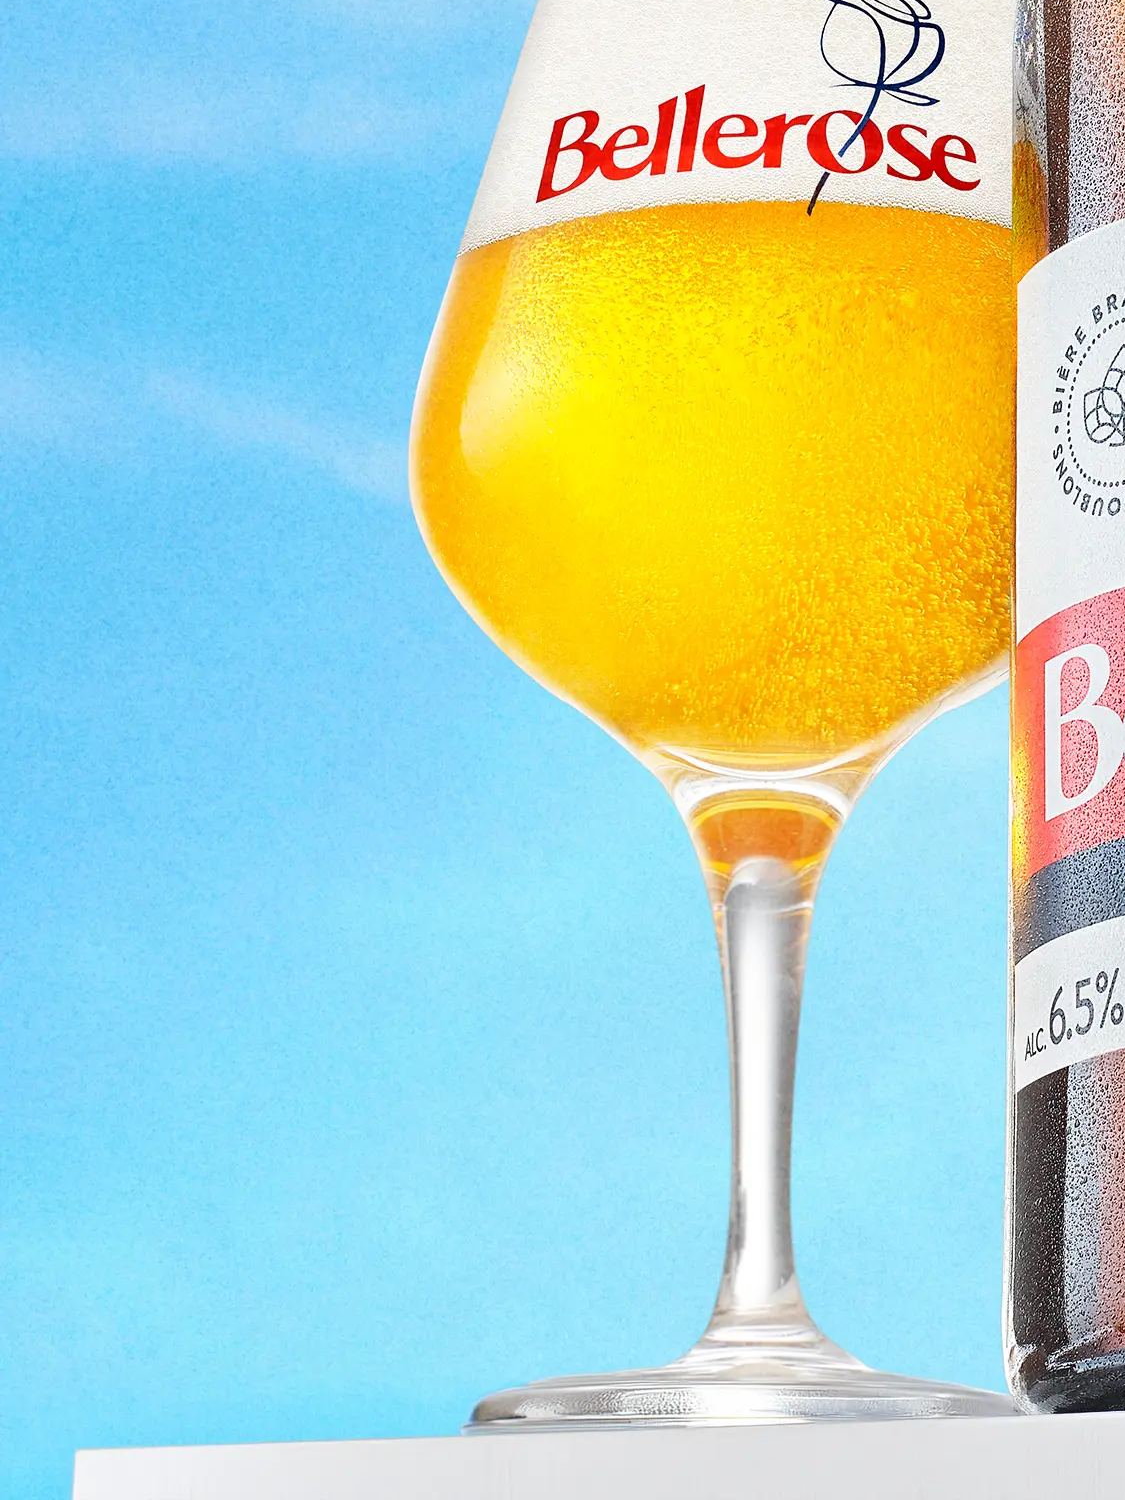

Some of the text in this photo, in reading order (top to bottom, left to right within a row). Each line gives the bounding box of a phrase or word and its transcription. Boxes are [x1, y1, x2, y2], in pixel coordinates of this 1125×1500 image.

[536, 83, 981, 203] Bellerose
[1052, 326, 1087, 414] BIÈRE
[1024, 1028, 1047, 1061] ALC.
[1049, 967, 1124, 1045] 6.5%
